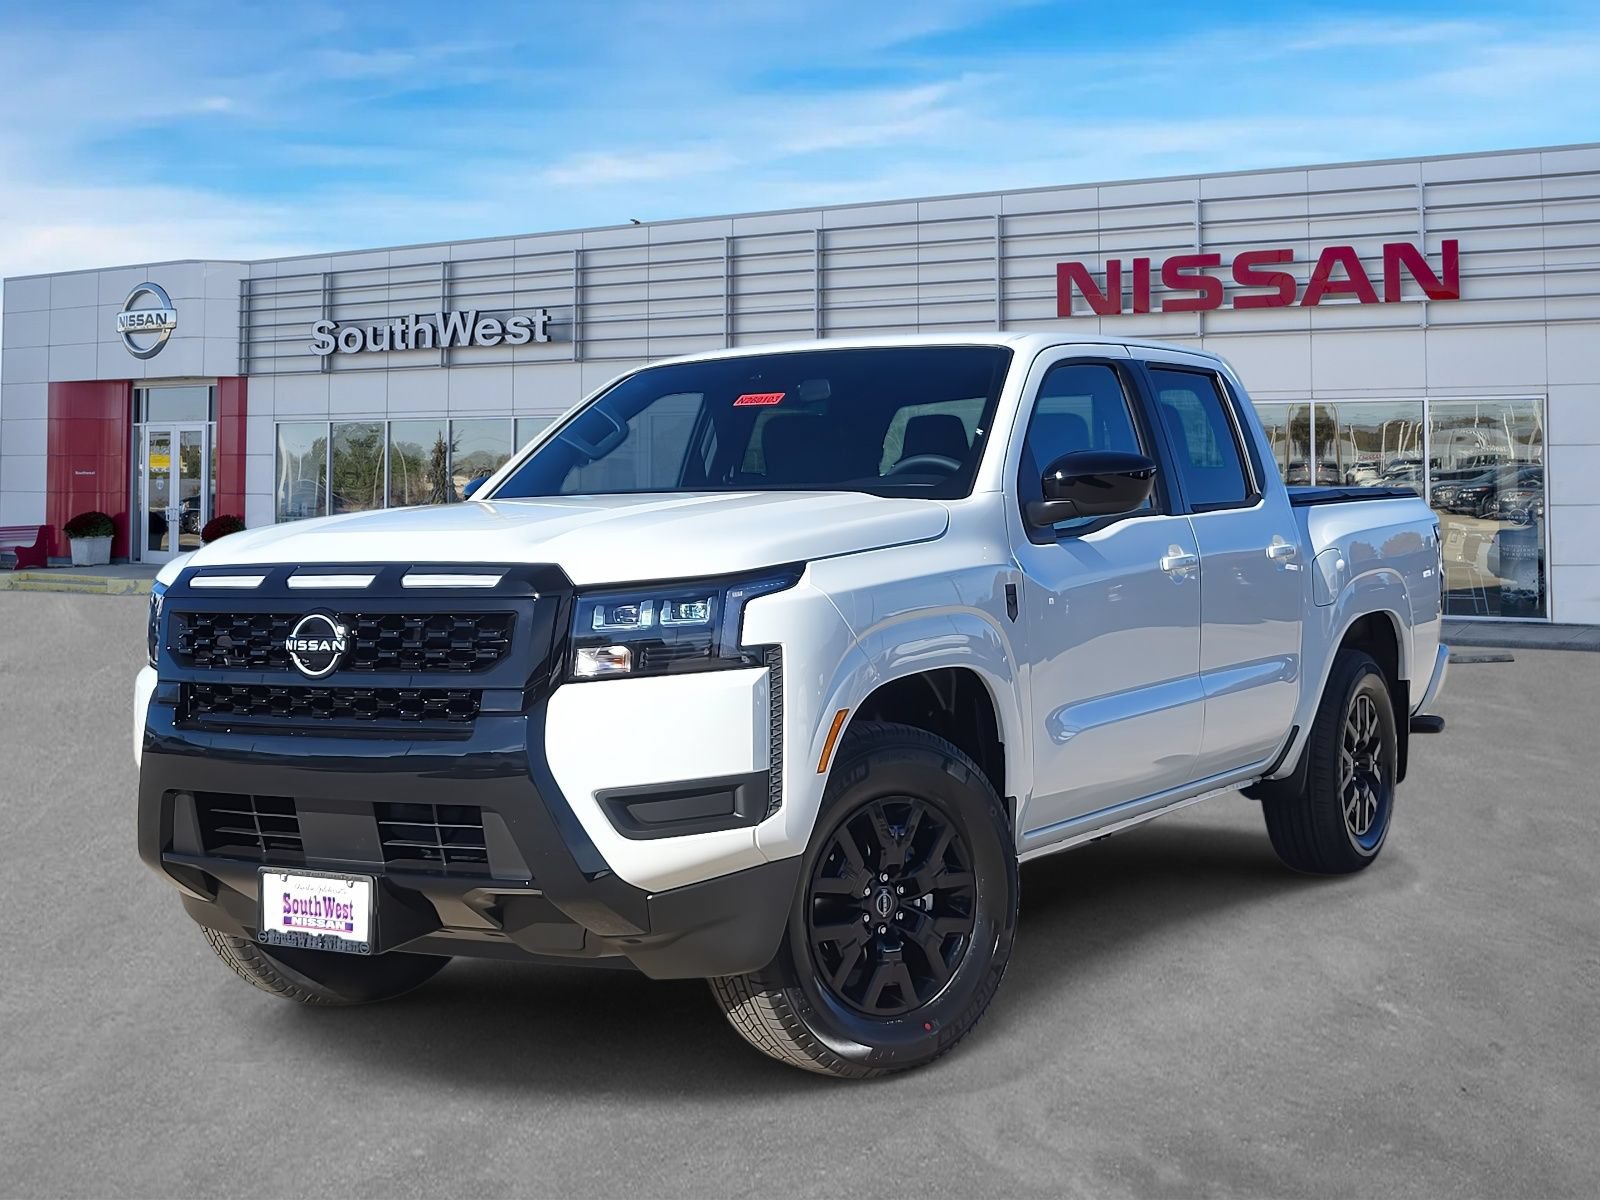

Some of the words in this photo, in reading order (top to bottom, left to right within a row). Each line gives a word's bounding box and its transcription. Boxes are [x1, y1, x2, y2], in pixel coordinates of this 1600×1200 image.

[1056, 239, 1460, 317] NISSAN
[119, 312, 168, 328] NISSAN
[308, 309, 552, 356] SouthWest
[285, 639, 346, 651] NISSAN
[283, 892, 353, 920] SouthWest
[292, 916, 345, 930] NISSAN
